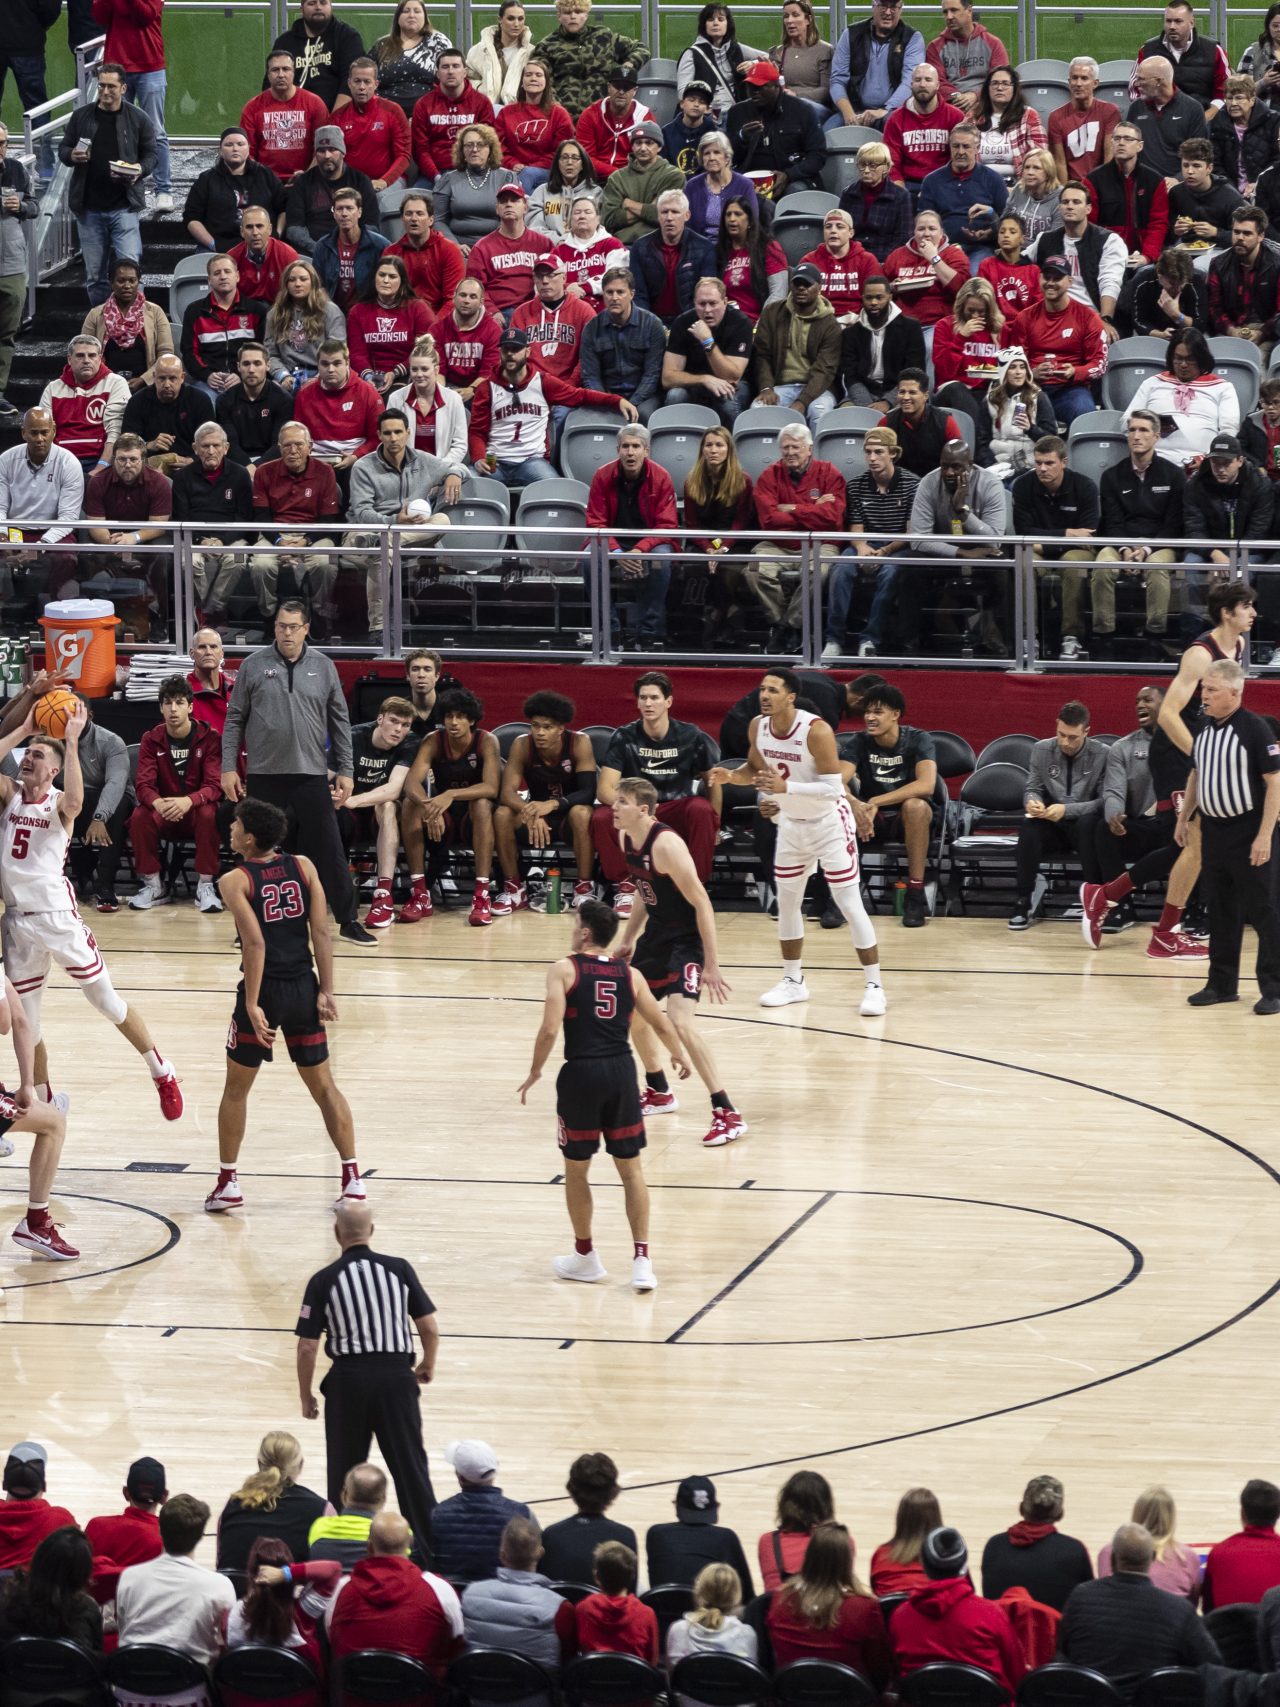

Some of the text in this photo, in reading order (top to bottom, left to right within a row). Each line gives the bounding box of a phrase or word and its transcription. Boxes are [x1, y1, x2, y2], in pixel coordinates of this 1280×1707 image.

[263, 110, 305, 124] WISCONSIN
[429, 113, 476, 125] WISCONSIN
[364, 331, 408, 343] WISCONSIN
[494, 401, 543, 421] WISCONSIN
[57, 633, 79, 657] G
[639, 747, 679, 759] STANFORD
[762, 749, 802, 763] WISCONSIN
[869, 753, 904, 767] STANFORD
[10, 828, 32, 860] 5
[261, 879, 305, 923] 23
[595, 980, 618, 1020] 5
